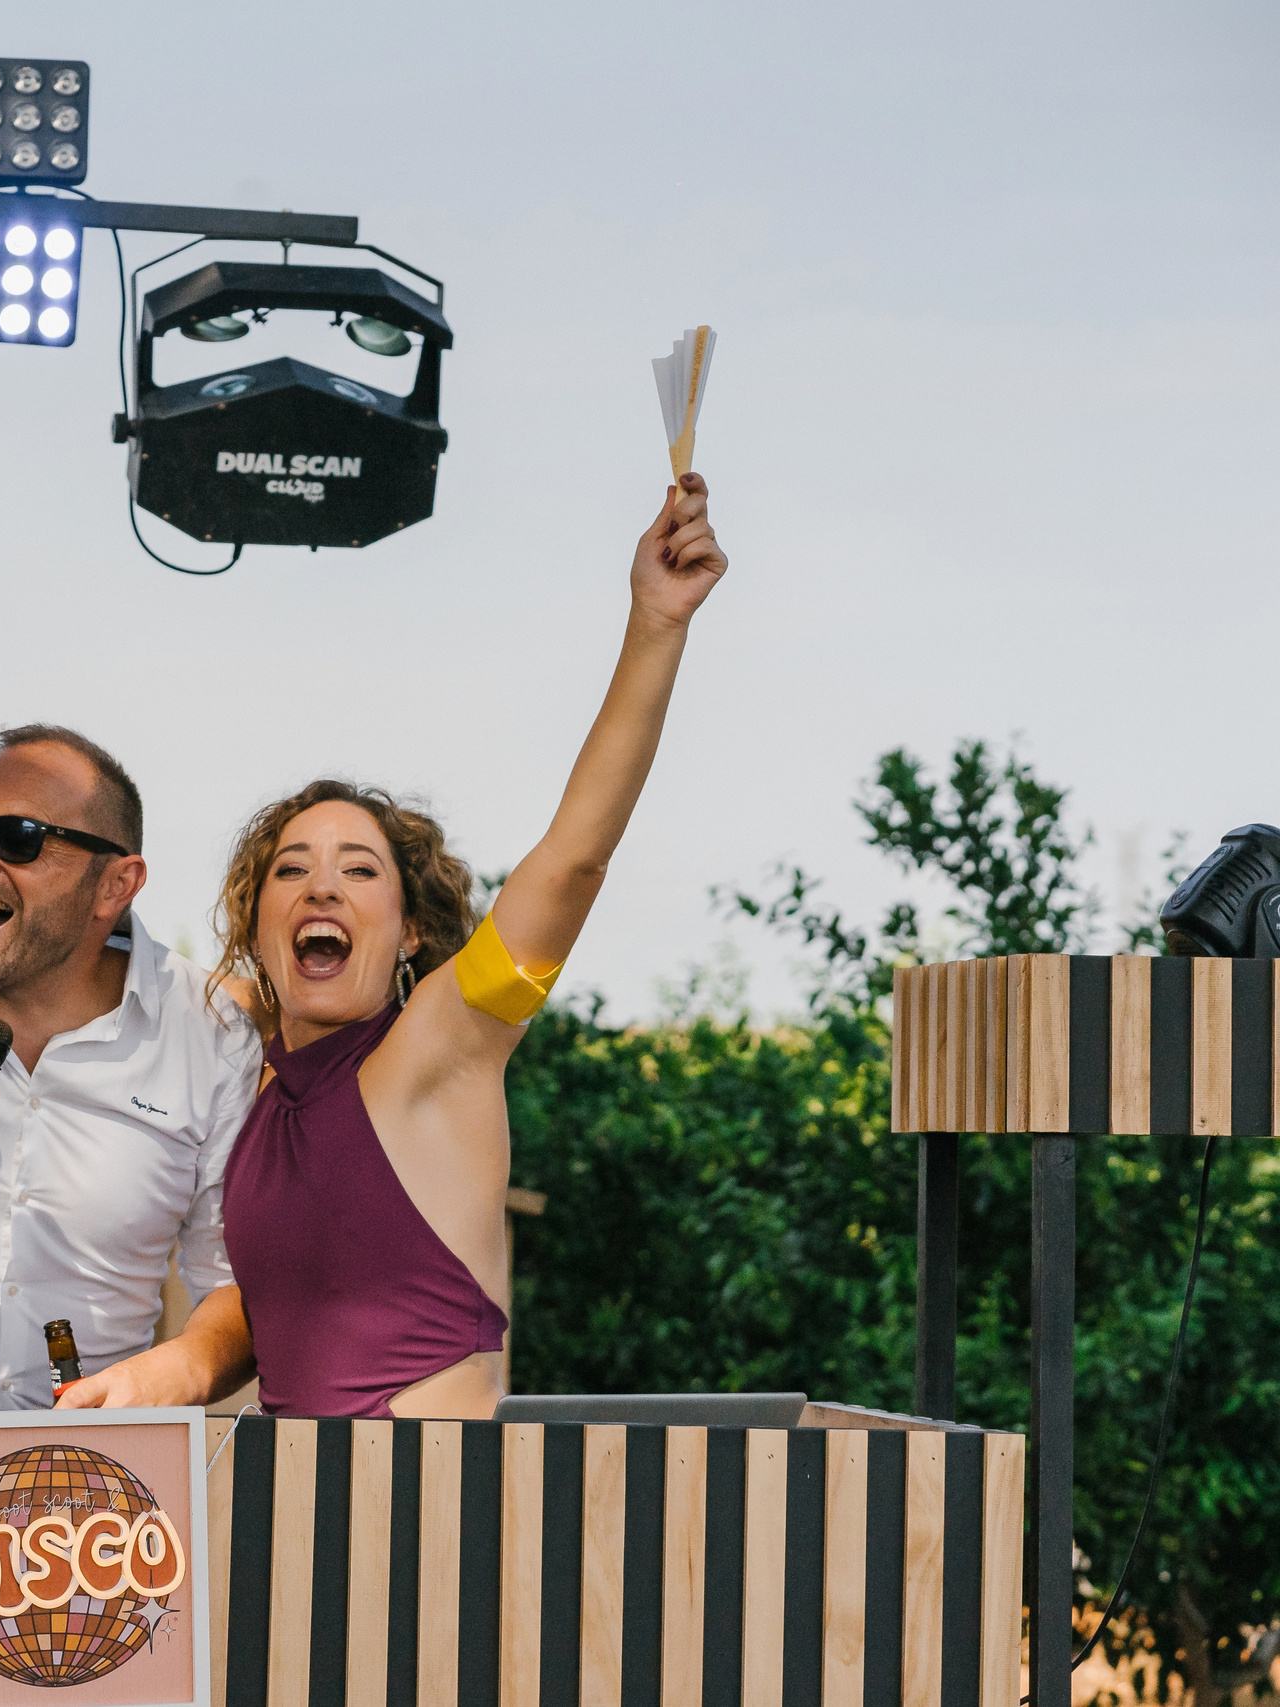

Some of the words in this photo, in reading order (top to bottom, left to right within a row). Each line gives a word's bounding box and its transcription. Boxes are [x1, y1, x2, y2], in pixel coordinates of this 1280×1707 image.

[216, 451, 287, 475] DUAL
[289, 454, 362, 478] SCAN
[265, 478, 325, 496] CLOUD
[42, 1488, 96, 1514] scoot
[106, 1487, 122, 1512] &
